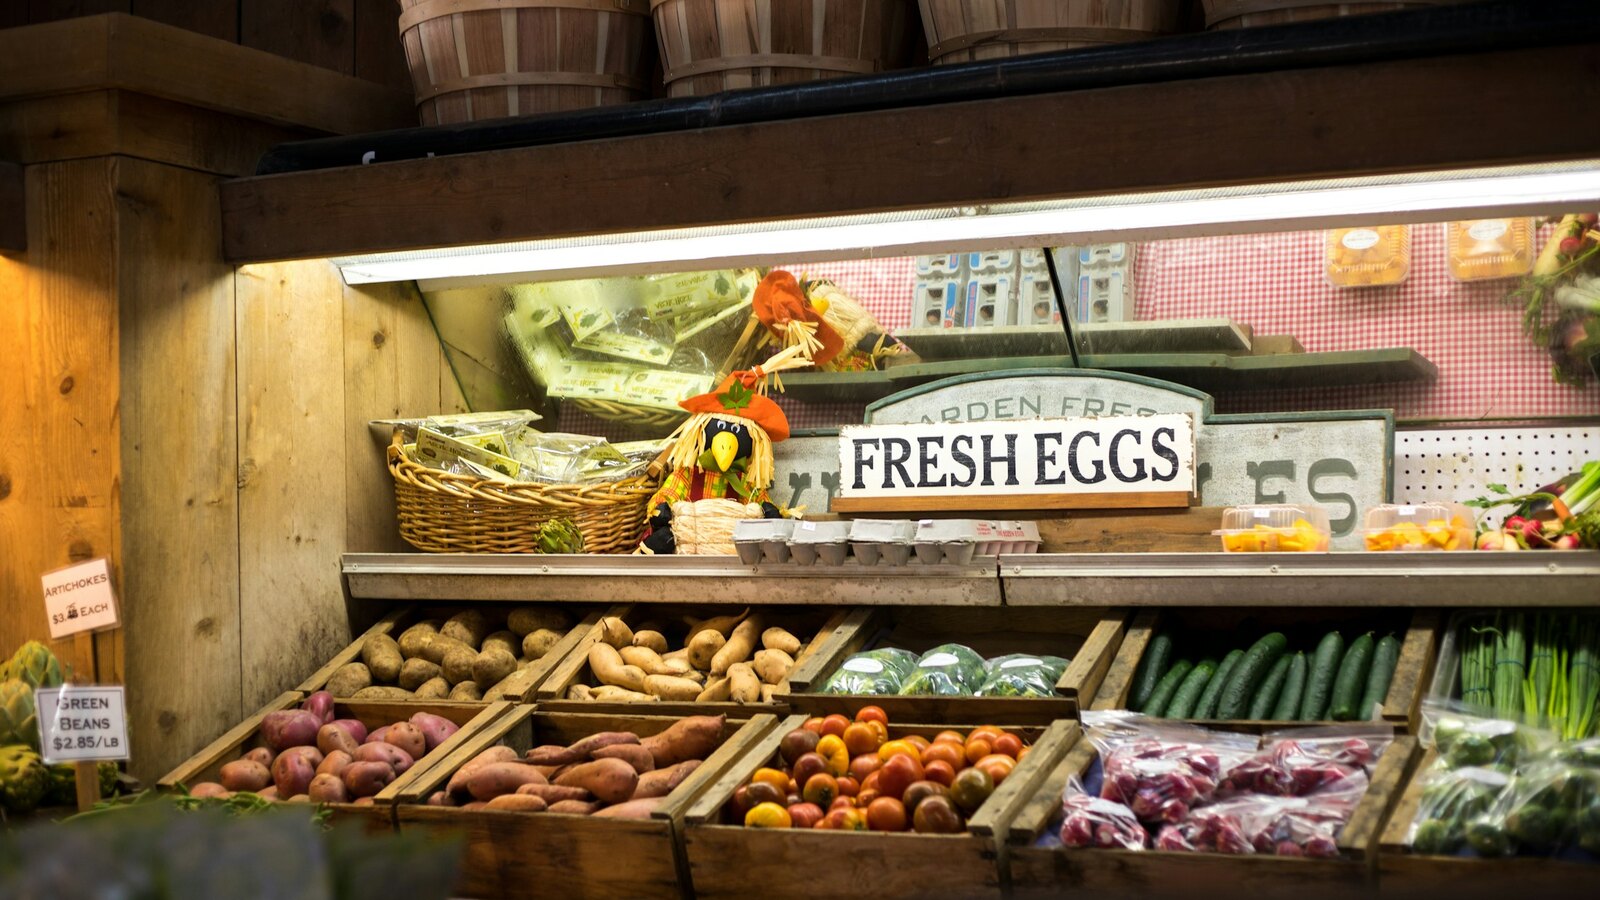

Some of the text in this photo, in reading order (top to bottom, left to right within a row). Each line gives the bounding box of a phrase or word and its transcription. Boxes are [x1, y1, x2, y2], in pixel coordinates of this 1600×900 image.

[851, 427, 1179, 489] FRESH EGGS
[45, 573, 107, 598] ARTICHOKES
[80, 603, 108, 616] EACH
[56, 697, 109, 710] GREEN
[60, 717, 110, 731] BEANS
[53, 736, 119, 751] $2.85/LB
